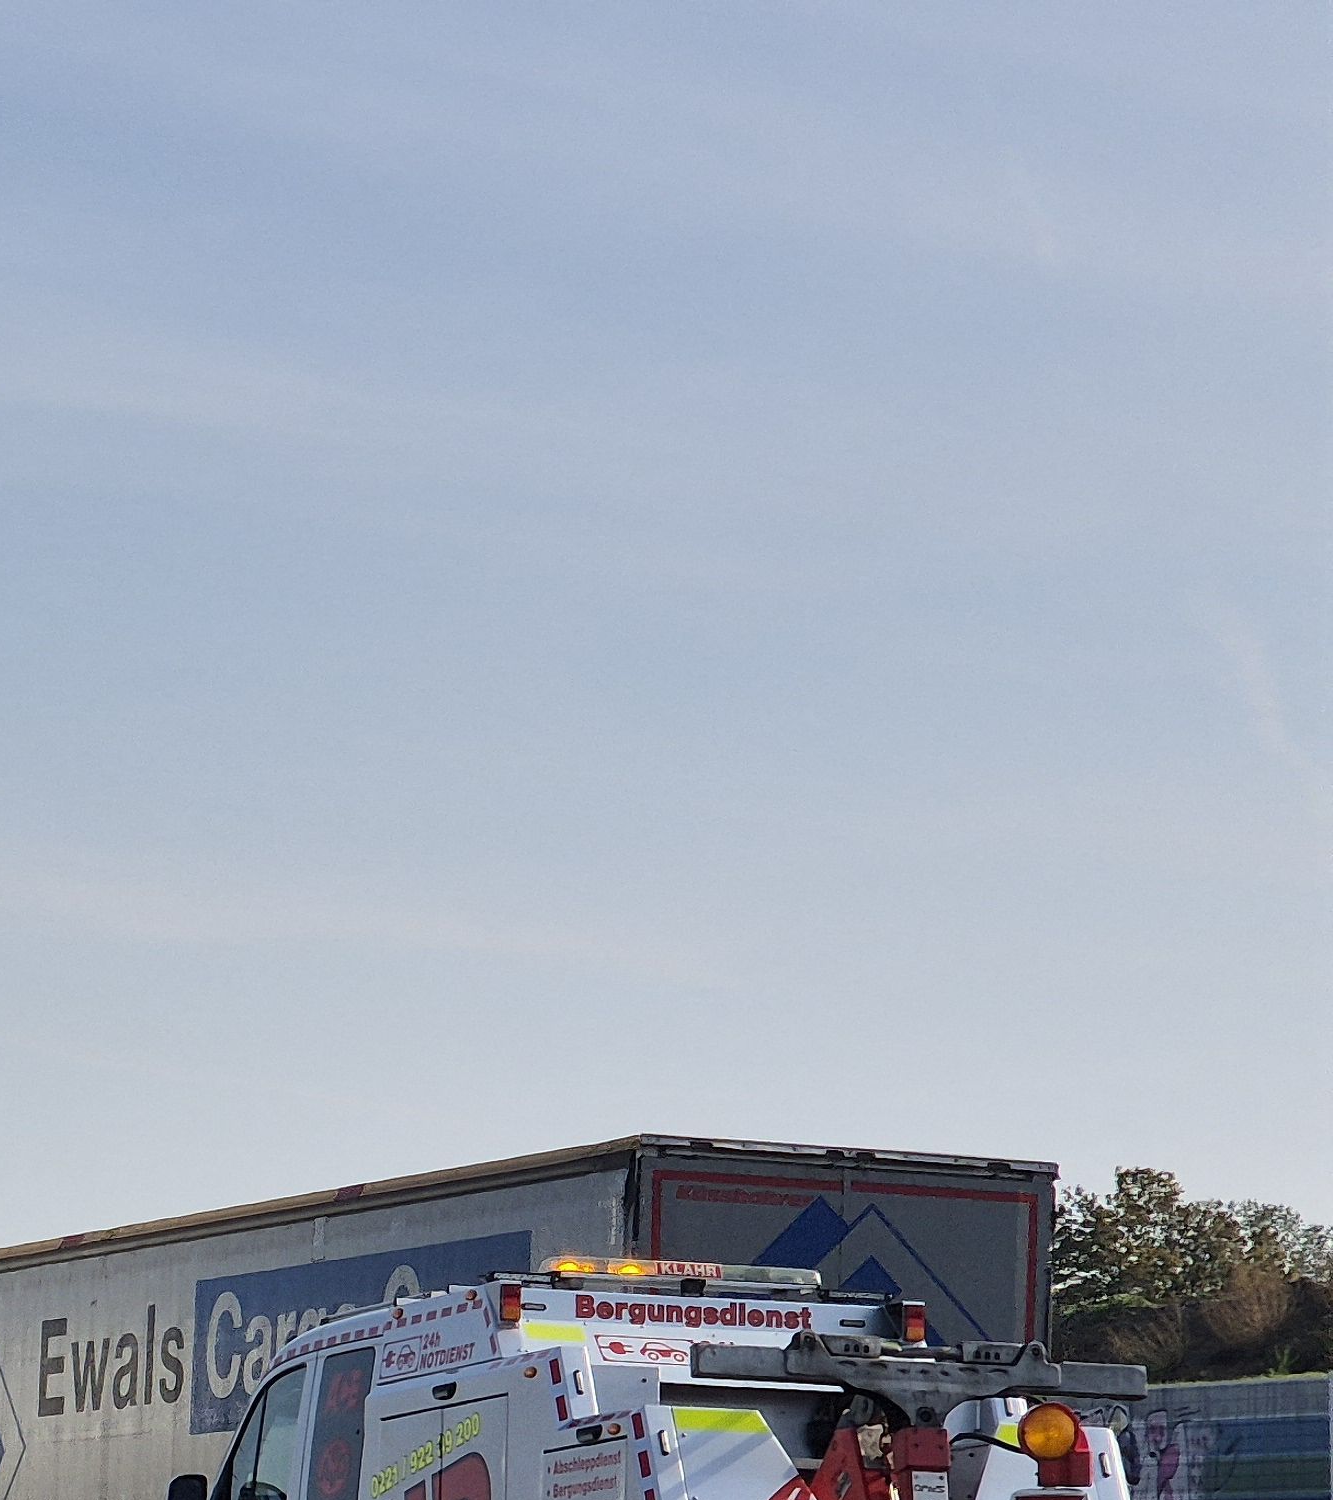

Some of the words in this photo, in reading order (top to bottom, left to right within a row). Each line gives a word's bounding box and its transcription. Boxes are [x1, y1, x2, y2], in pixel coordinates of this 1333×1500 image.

[660, 1263, 718, 1277] KLAHR
[575, 1294, 812, 1329] Bergungsdienst
[38, 1303, 184, 1417] Ewals
[420, 1342, 475, 1369] NOTDIENST
[371, 1462, 398, 1499] 0221
[410, 1440, 433, 1474] 922
[456, 1412, 481, 1447] 200
[553, 1451, 621, 1475] Abschleppdienst
[553, 1476, 617, 1498] Bergungsdienst
